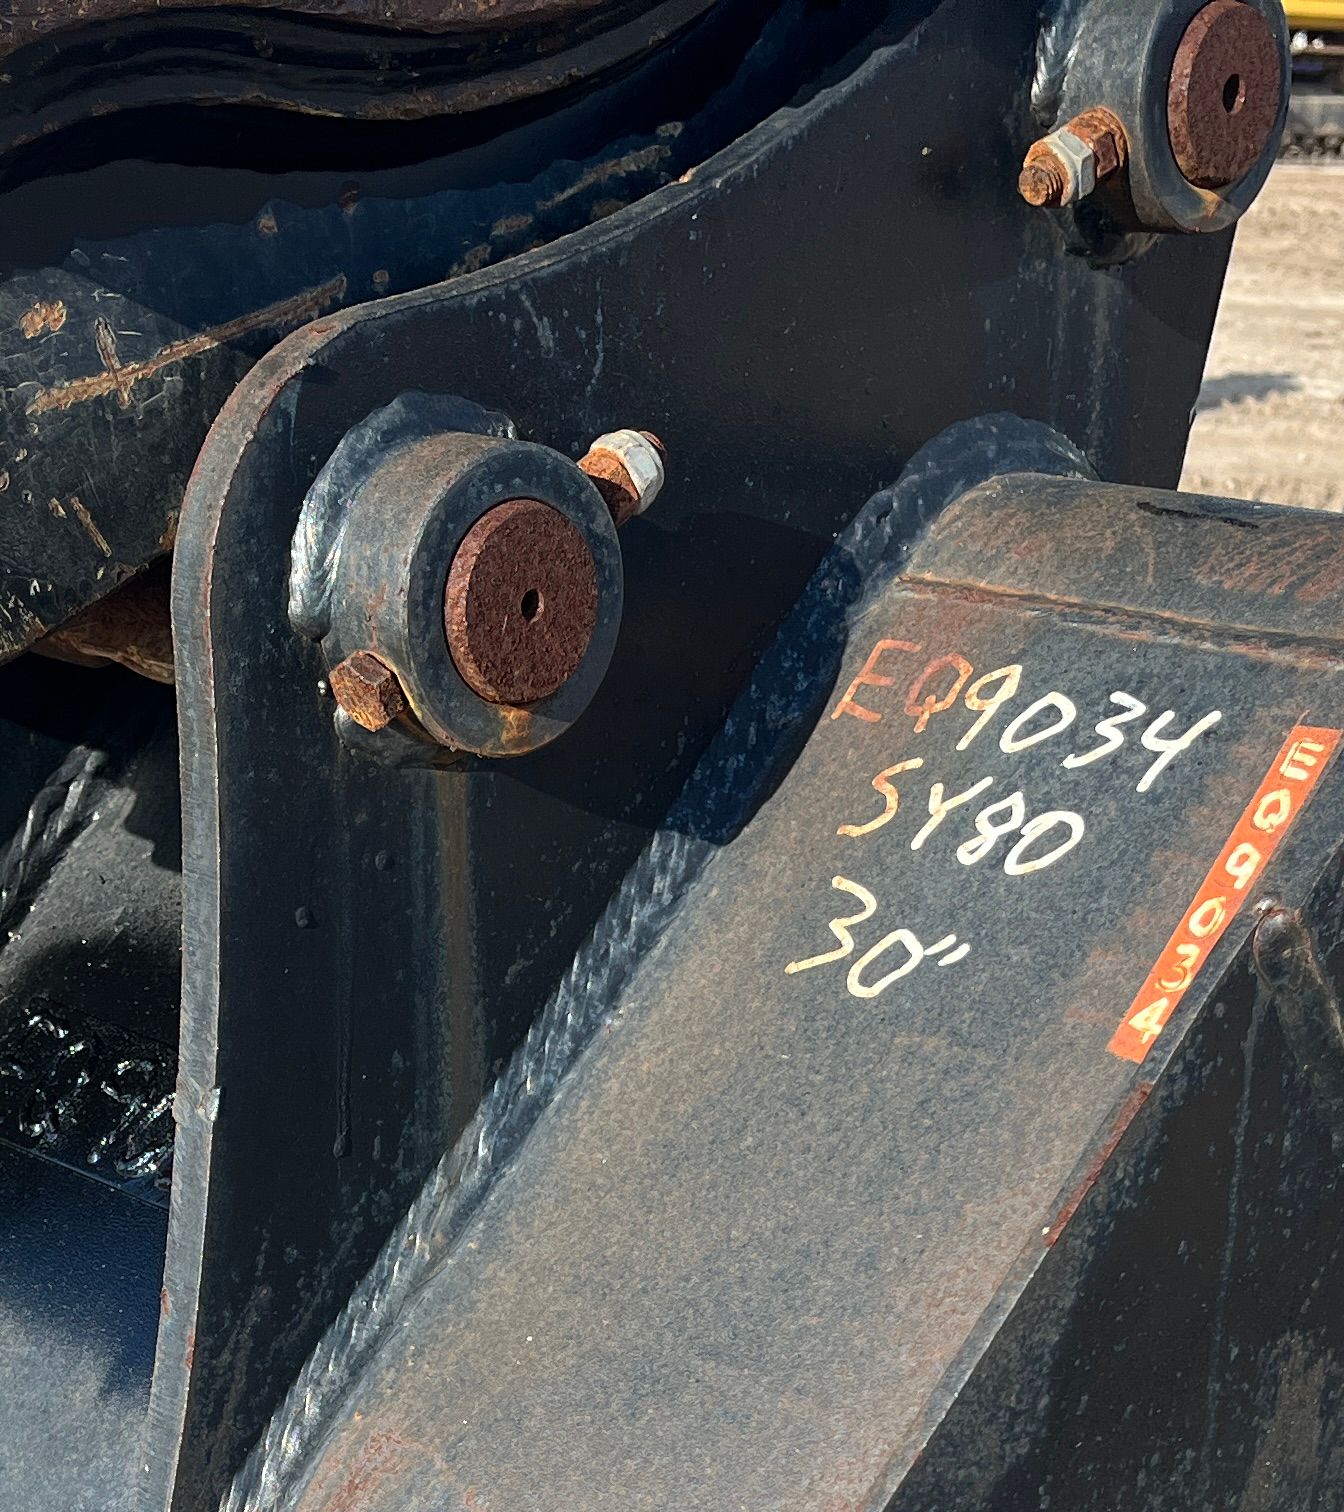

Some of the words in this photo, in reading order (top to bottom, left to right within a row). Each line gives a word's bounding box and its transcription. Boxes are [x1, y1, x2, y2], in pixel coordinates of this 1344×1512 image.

[830, 639, 1223, 793] EQ9034
[836, 757, 1086, 876] SY80
[1127, 737, 1326, 1046] EQ9034
